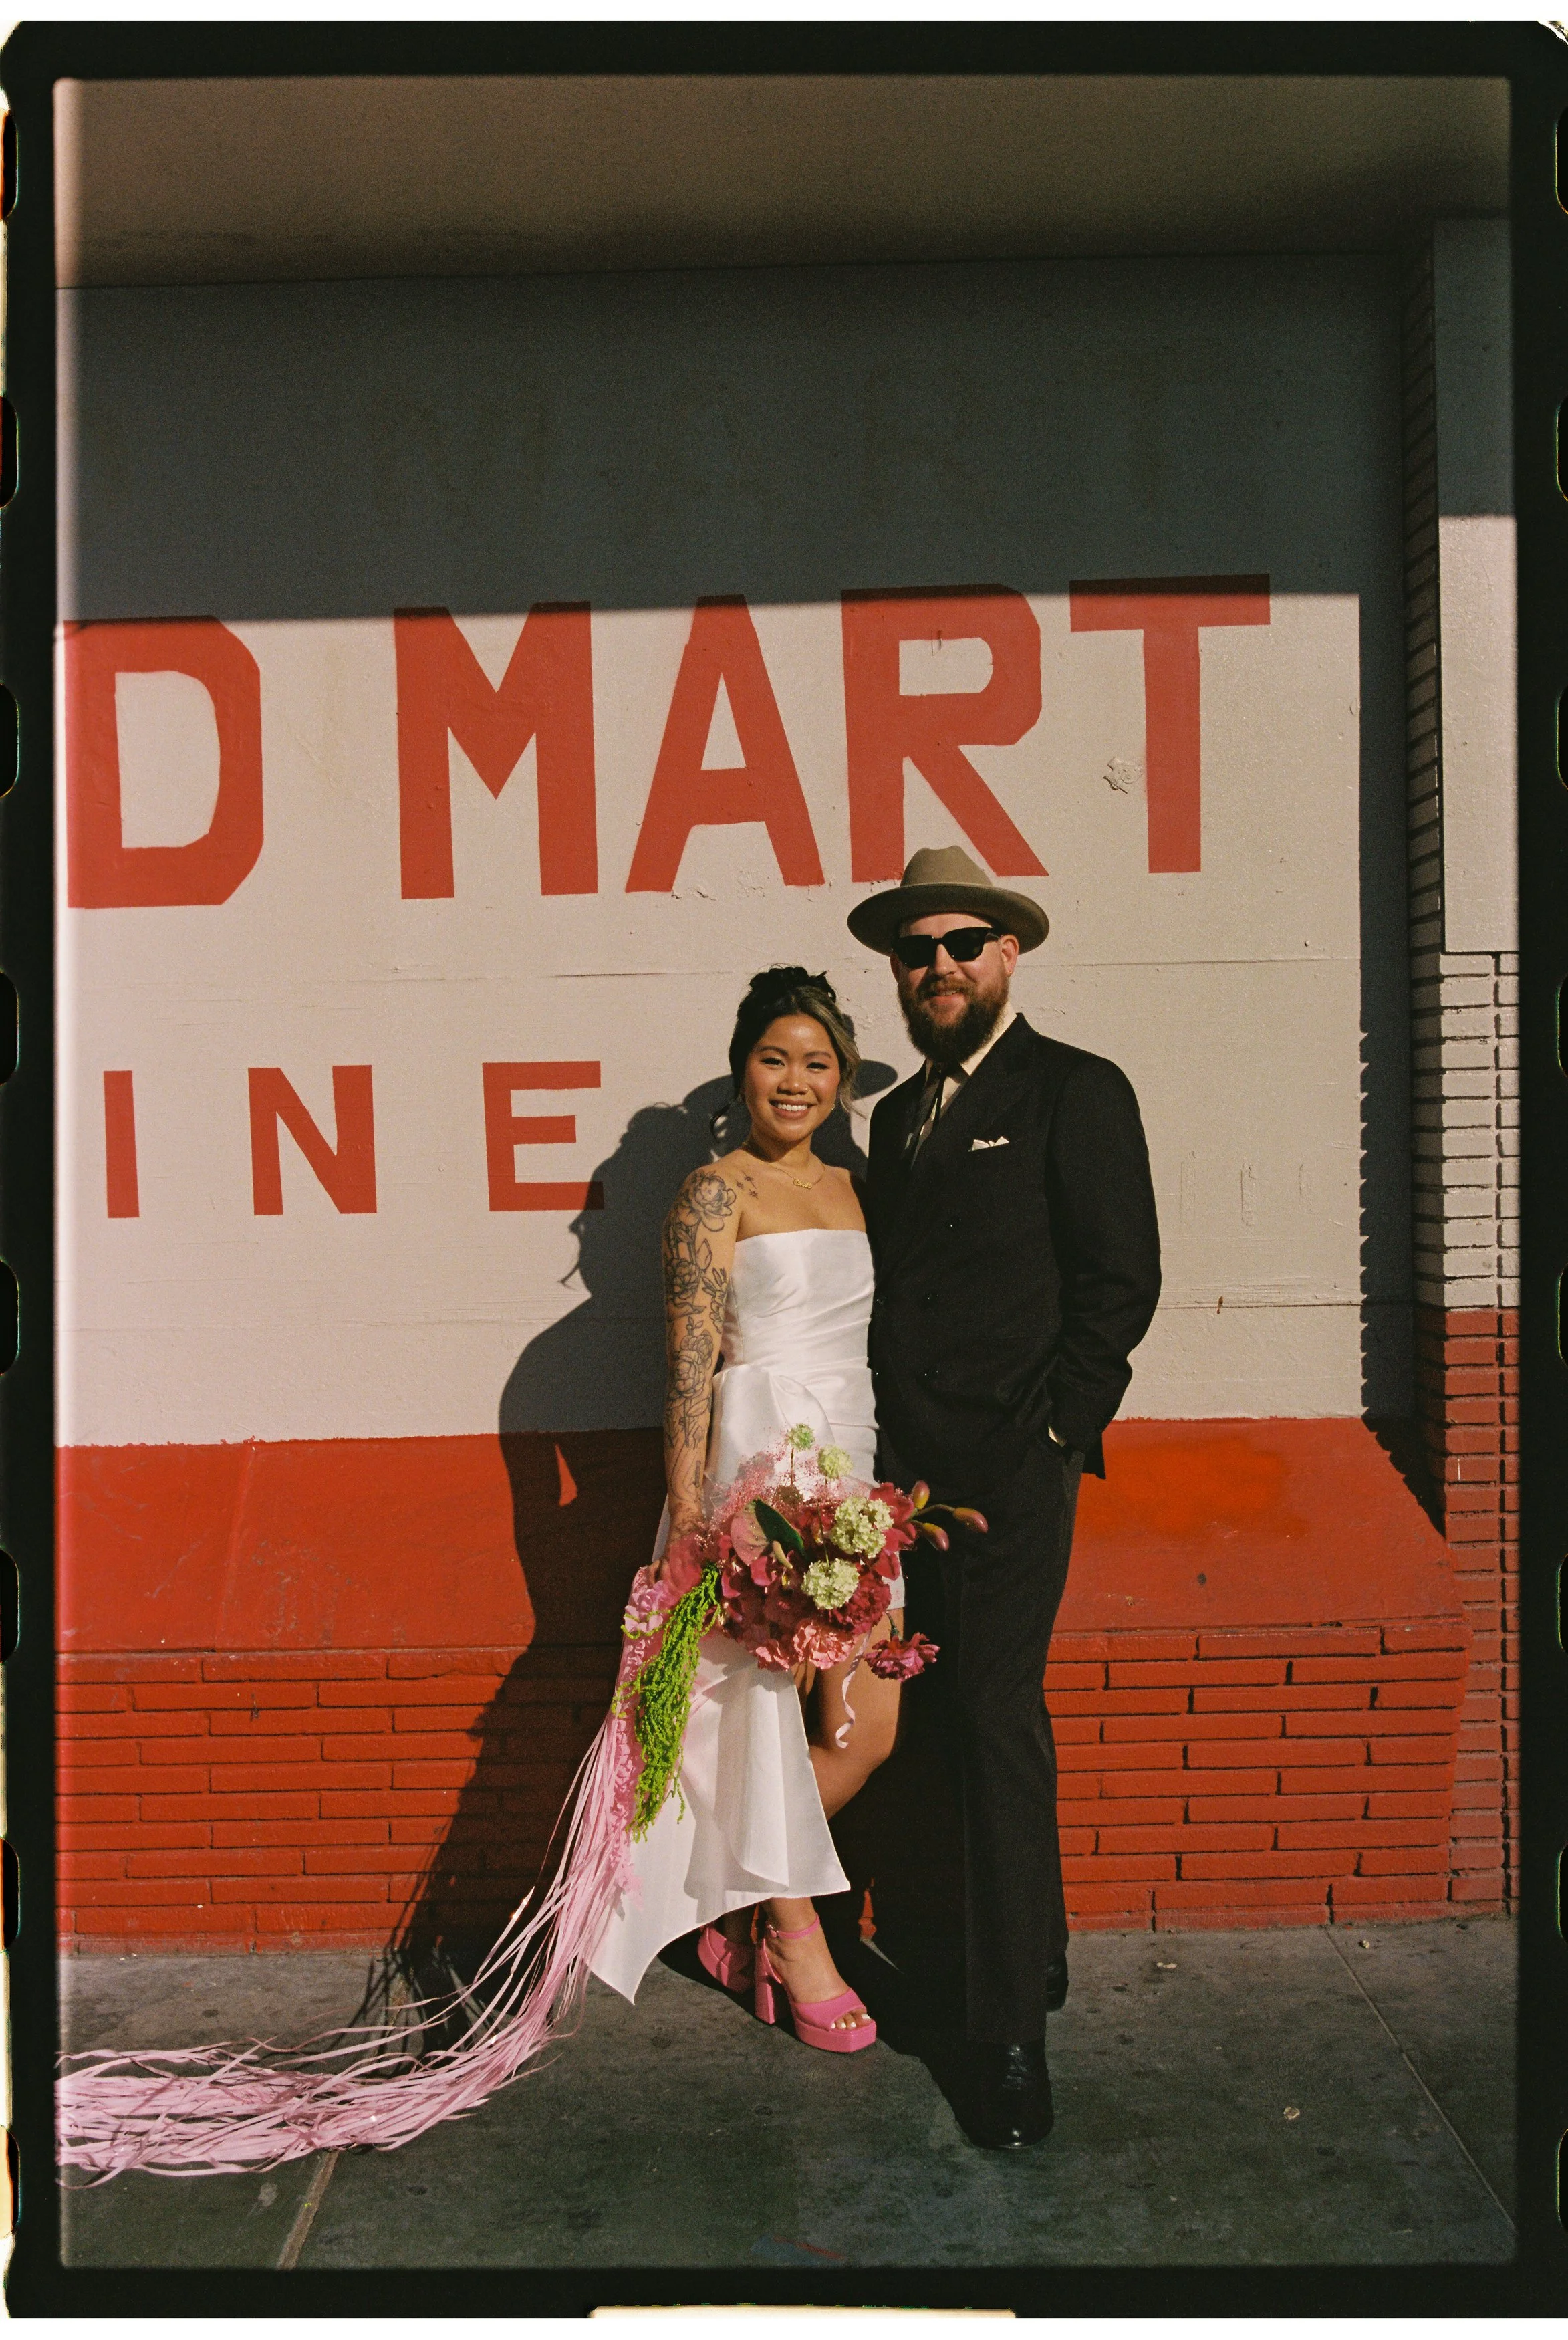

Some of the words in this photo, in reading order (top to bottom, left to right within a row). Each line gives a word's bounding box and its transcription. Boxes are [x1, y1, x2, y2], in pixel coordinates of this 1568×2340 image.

[63, 615, 265, 908] D
[393, 574, 1271, 899] MART
[103, 1060, 605, 1218] INE
